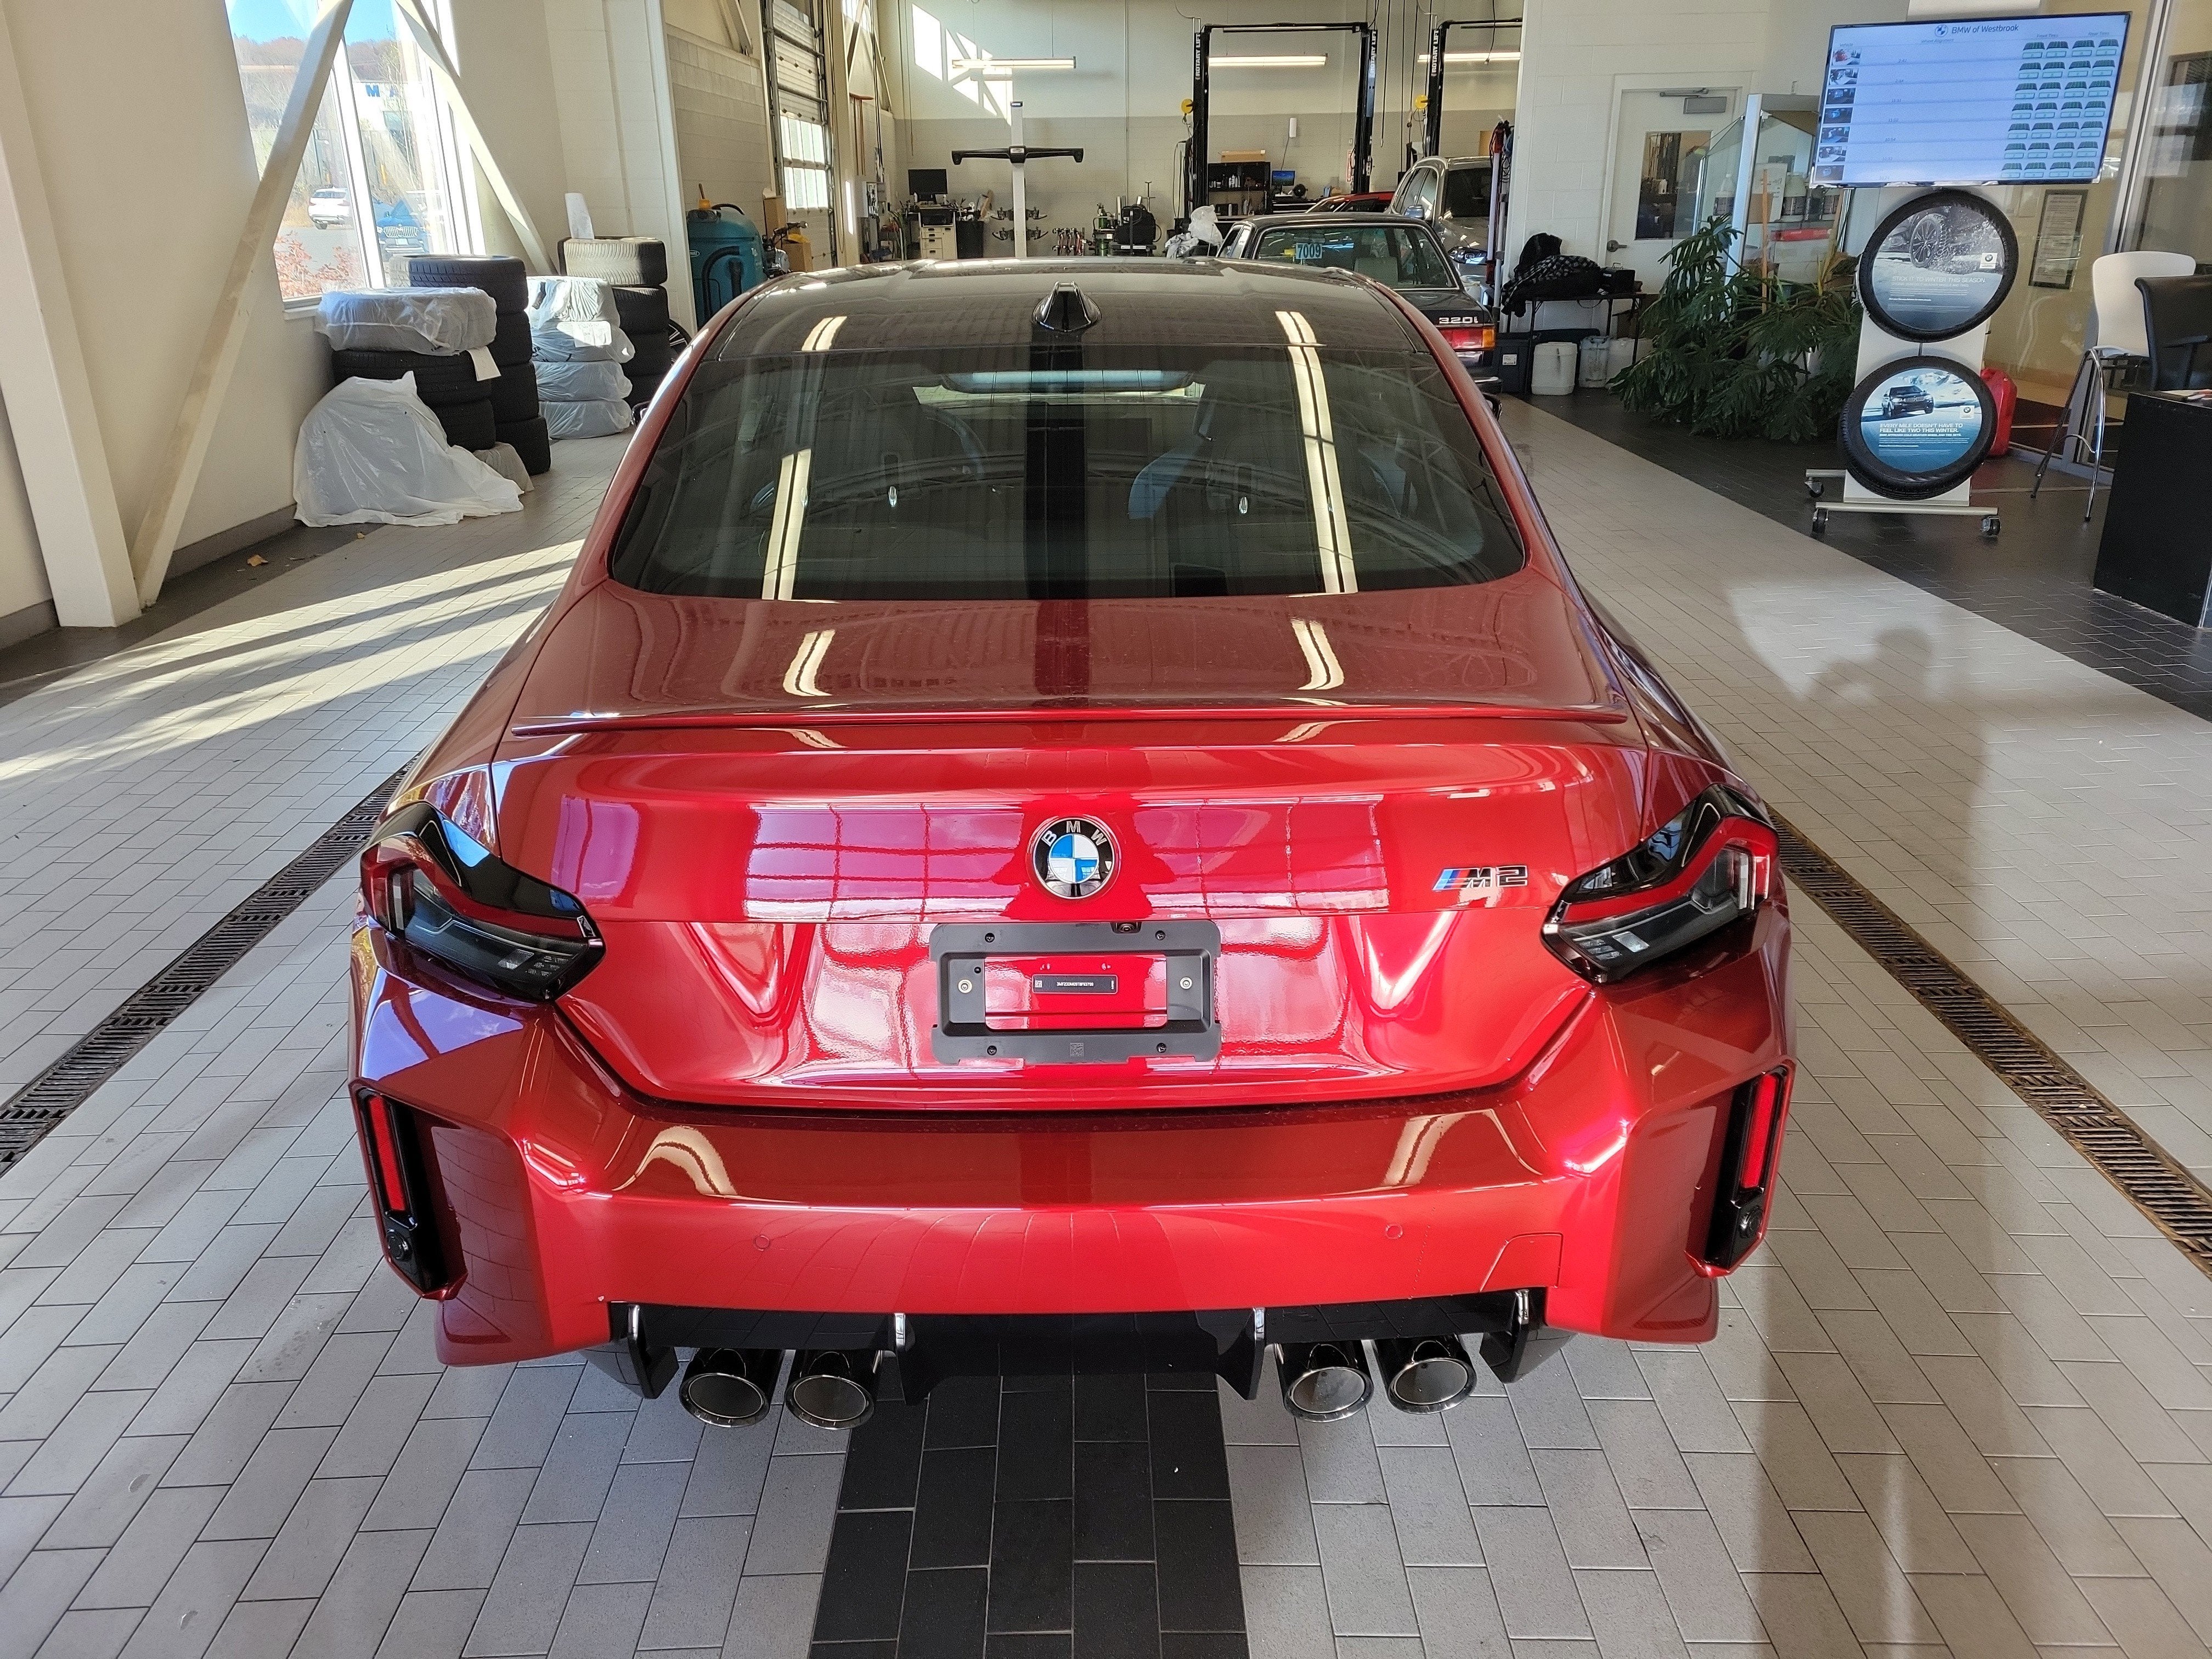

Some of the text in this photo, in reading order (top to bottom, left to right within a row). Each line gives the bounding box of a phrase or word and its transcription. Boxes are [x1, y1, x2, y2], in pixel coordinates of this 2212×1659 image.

[1982, 24, 2019, 32] Westbrook
[1297, 244, 1321, 258] 7009
[1041, 821, 1107, 847] BMW
[1432, 865, 1527, 890] M2
